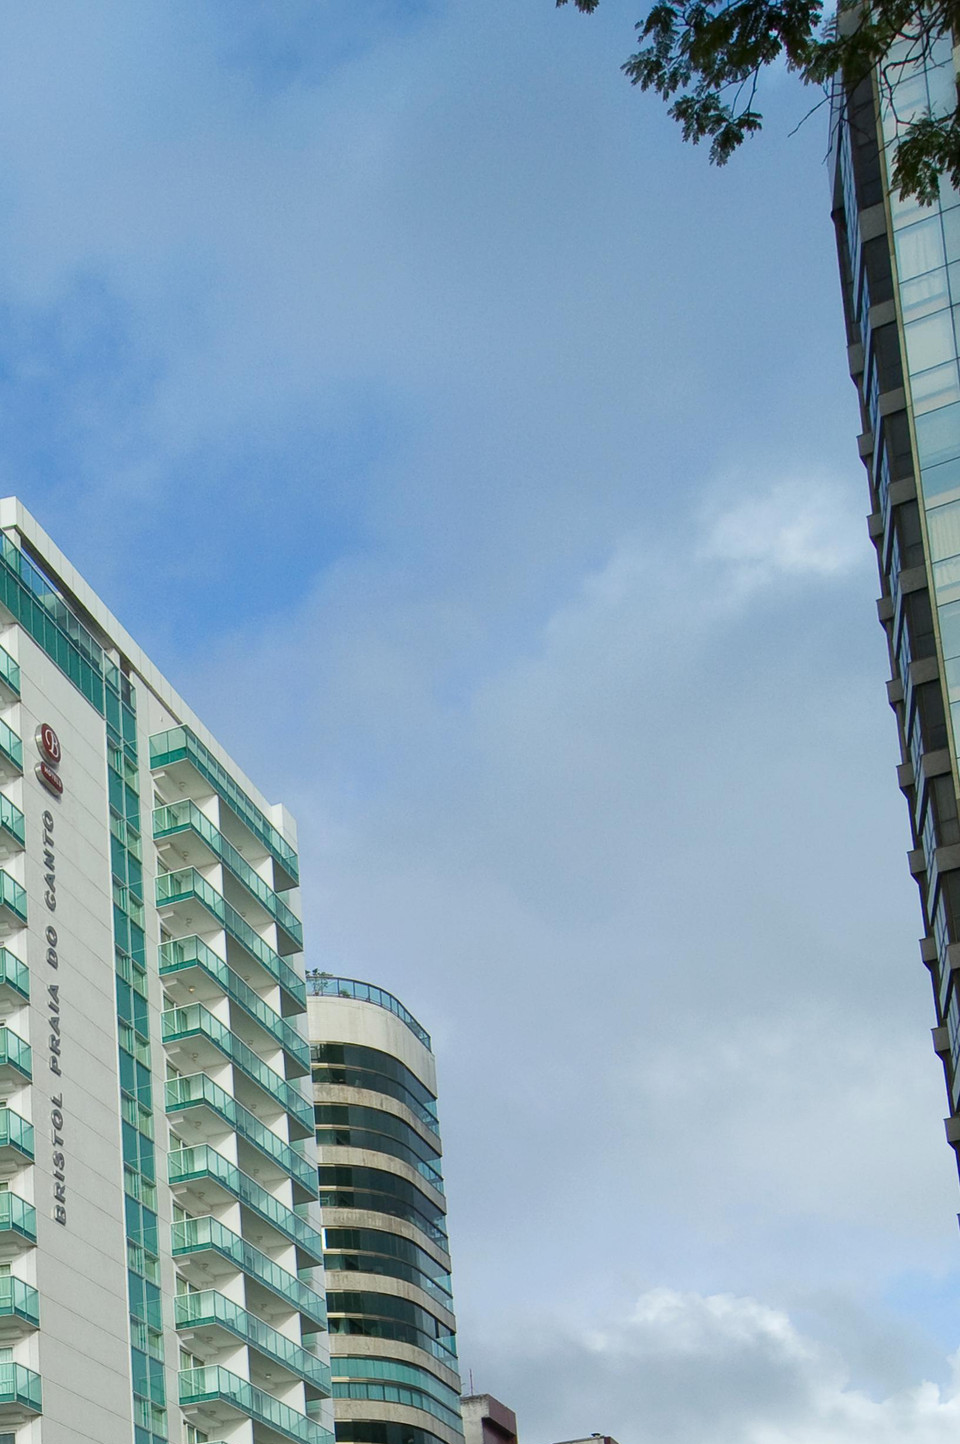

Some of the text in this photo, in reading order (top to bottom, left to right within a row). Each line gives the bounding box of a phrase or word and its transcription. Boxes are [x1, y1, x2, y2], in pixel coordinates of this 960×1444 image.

[45, 729, 59, 758] B
[42, 810, 67, 1226] BRISTOL PRAIA DO CANTO
